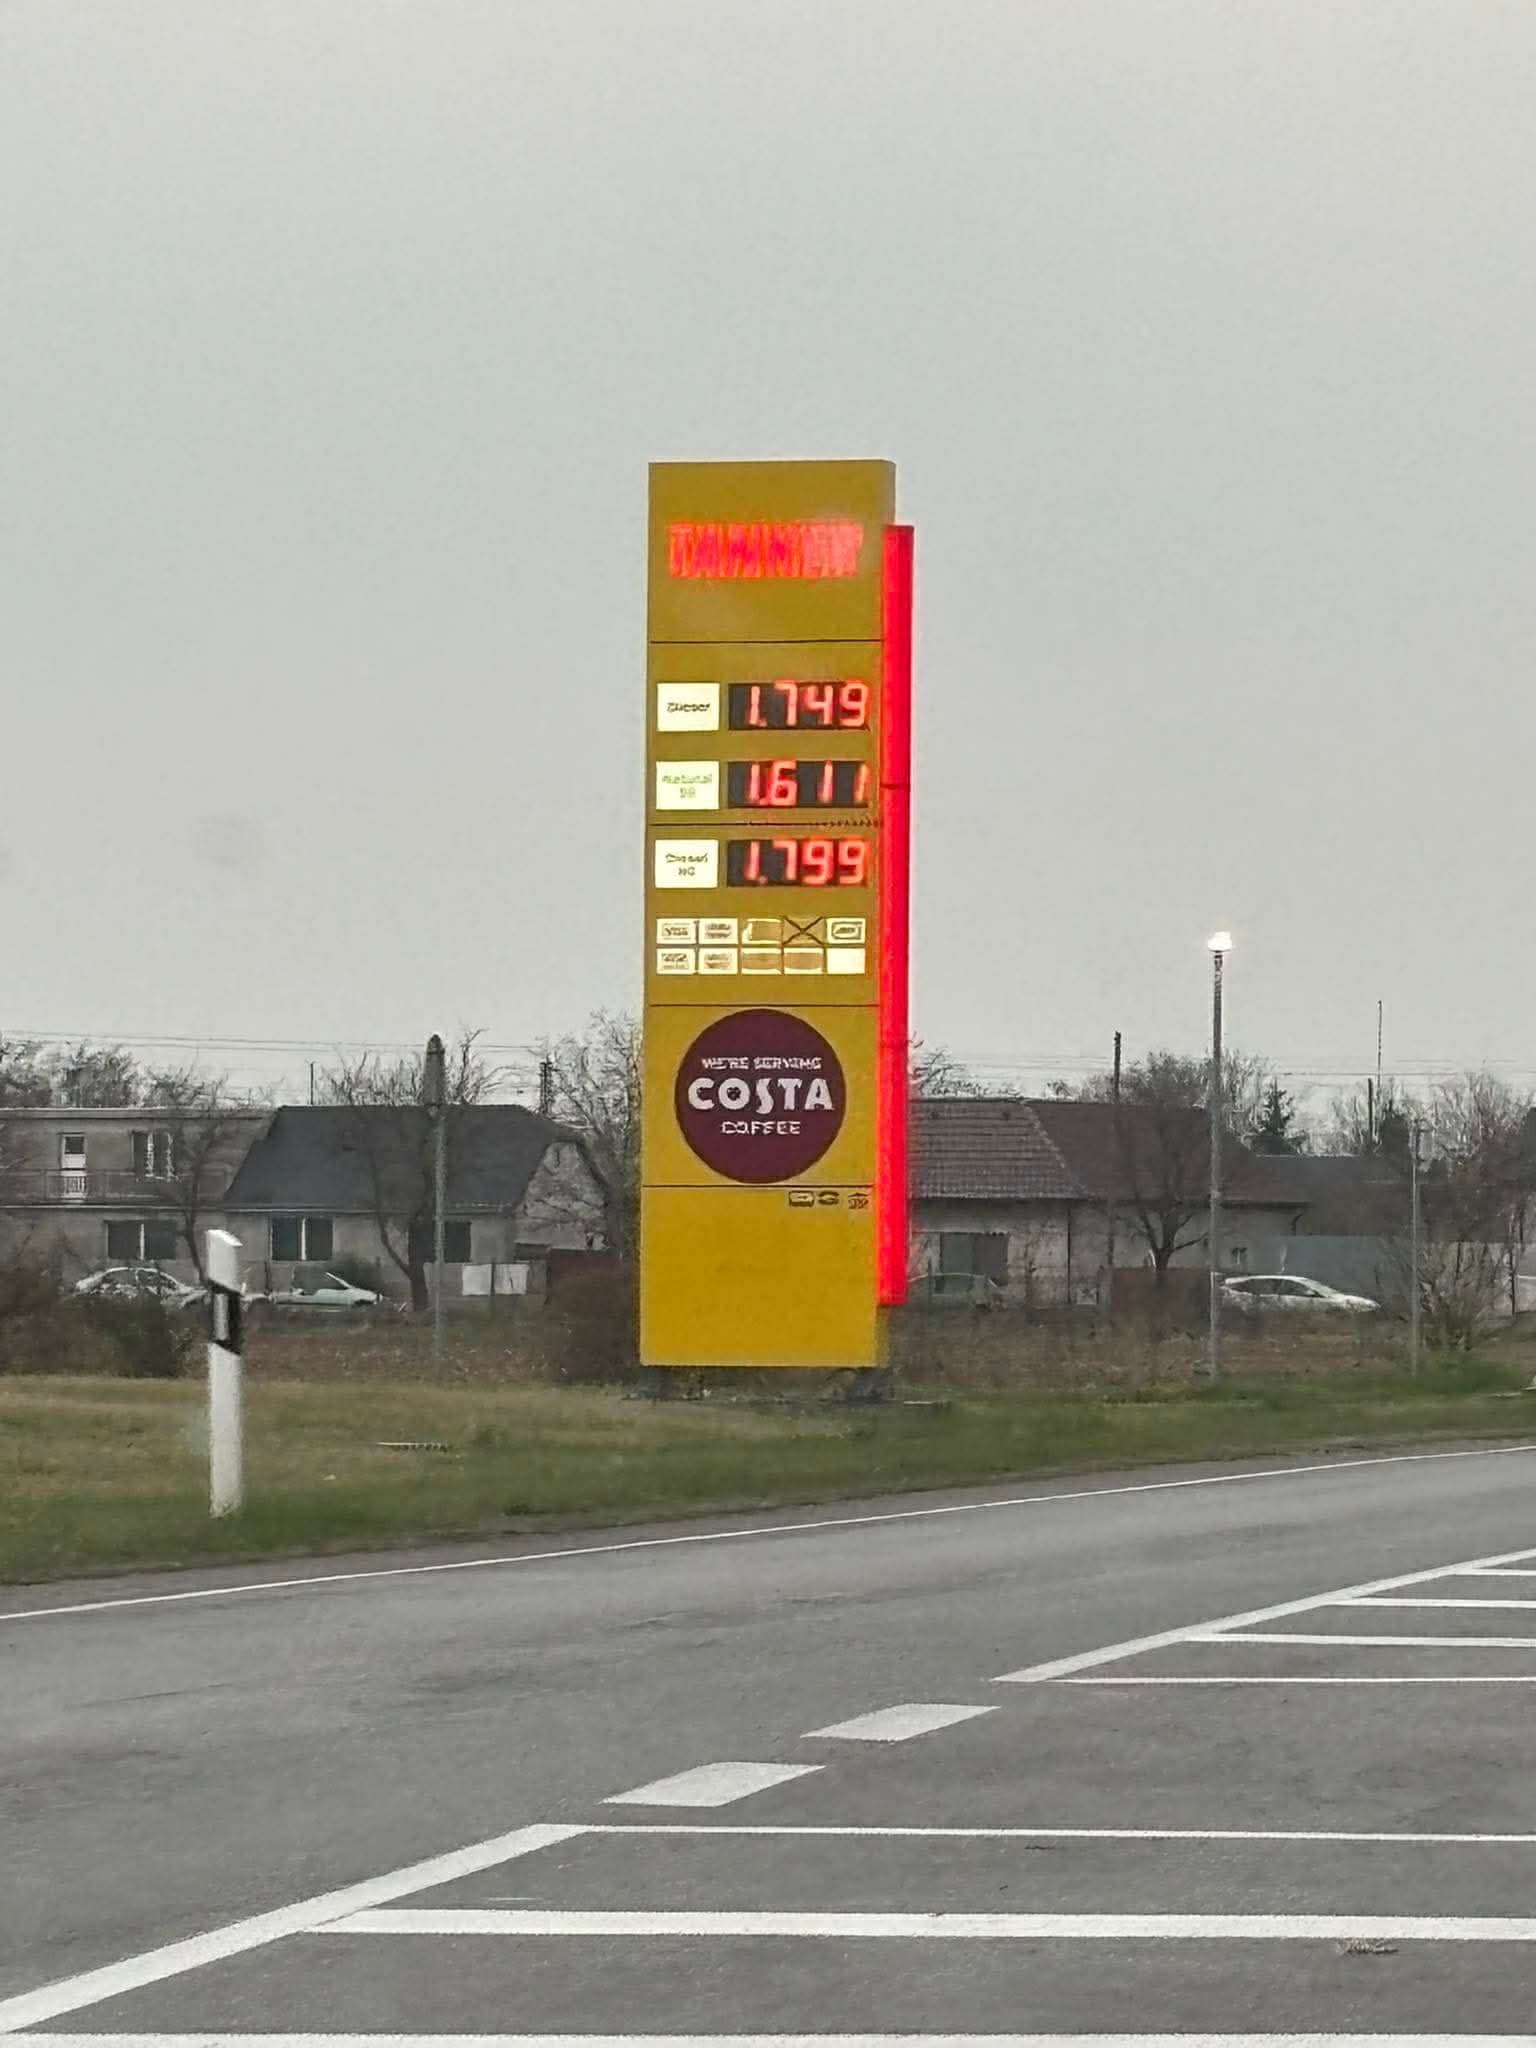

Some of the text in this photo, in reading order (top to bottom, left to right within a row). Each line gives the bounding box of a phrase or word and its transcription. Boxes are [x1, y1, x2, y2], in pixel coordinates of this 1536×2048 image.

[747, 680, 868, 727] 1.749
[748, 760, 869, 806] 1.611
[746, 839, 867, 885] 1.799
[753, 1056, 822, 1070] SERVING
[687, 1077, 835, 1115] COSTA
[721, 1121, 801, 1136] COFFEE
